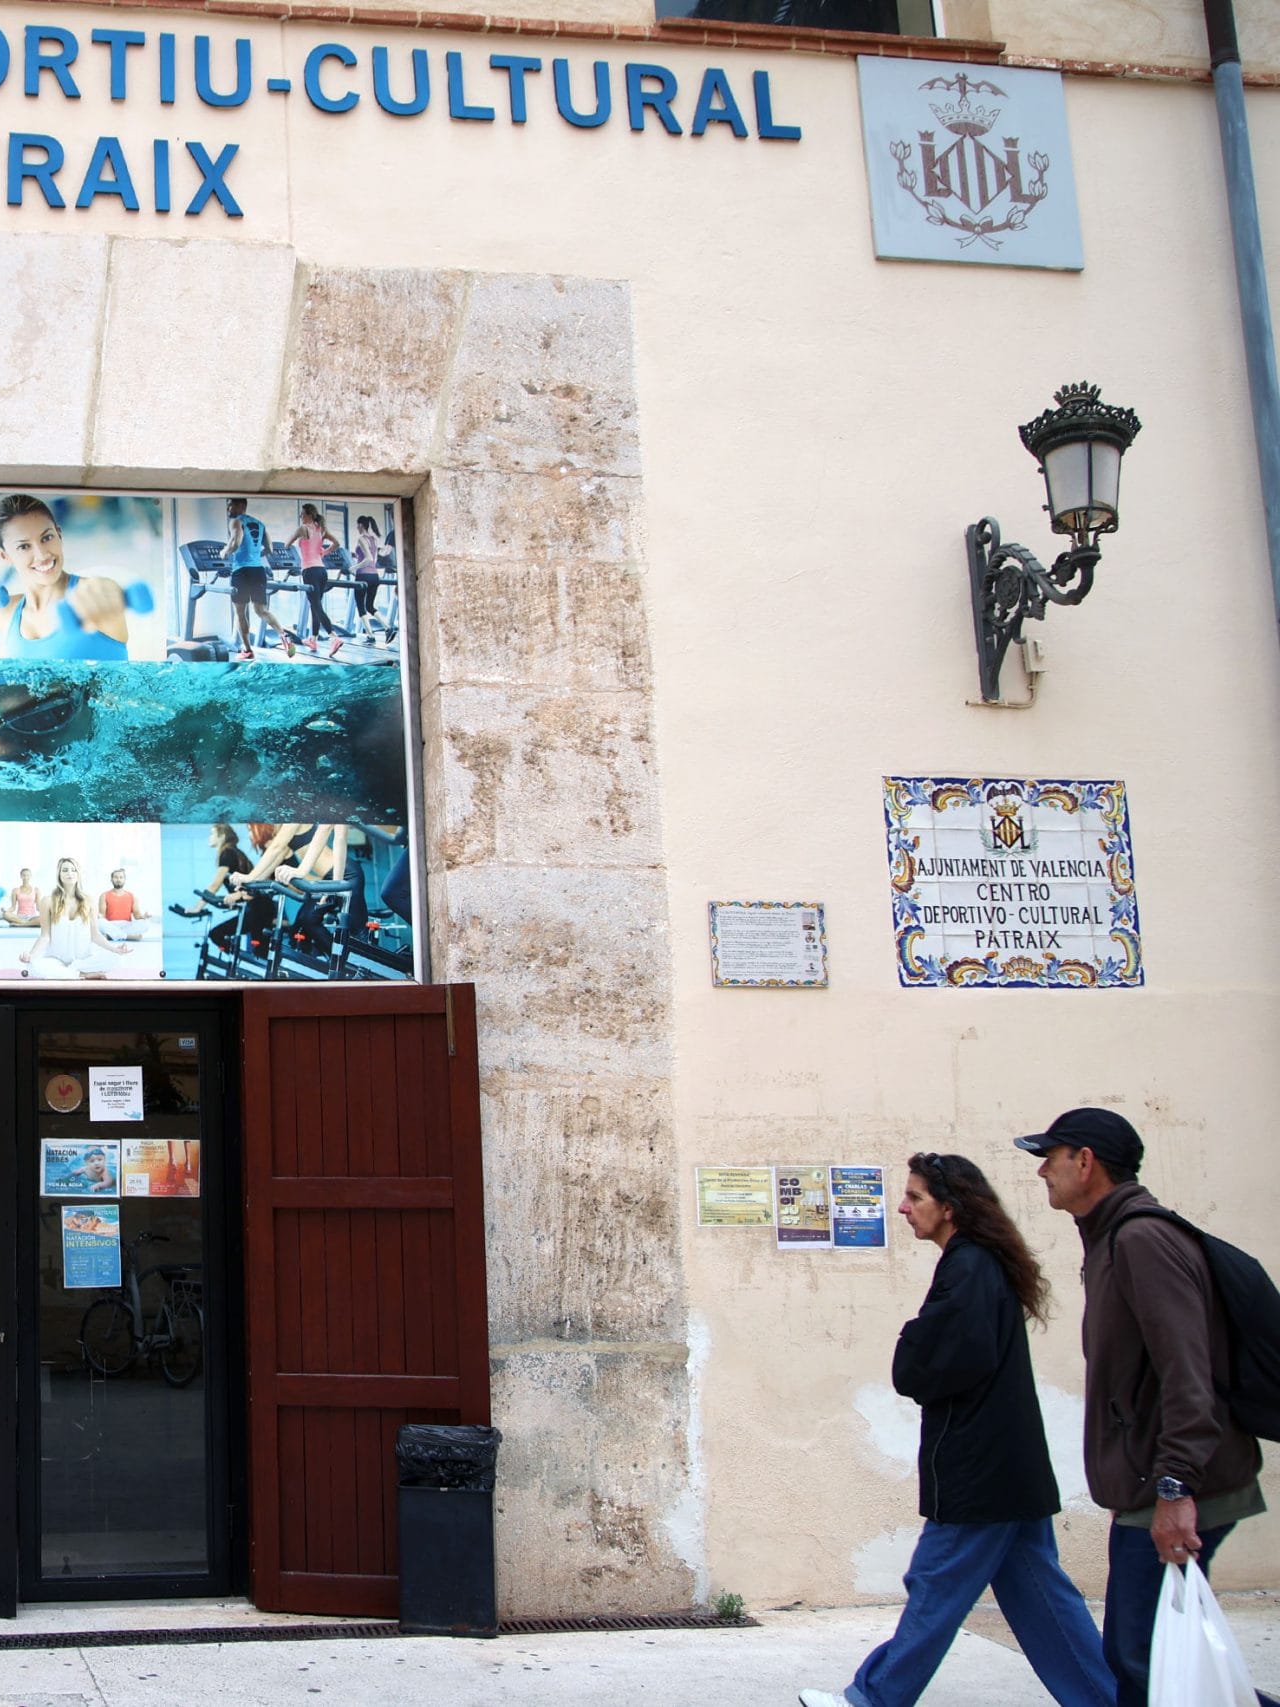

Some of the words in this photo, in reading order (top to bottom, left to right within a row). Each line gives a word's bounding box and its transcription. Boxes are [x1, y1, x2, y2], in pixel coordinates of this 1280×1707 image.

[917, 858, 1007, 877] AJUNTAMENT
[1012, 859, 1027, 877] DE
[1029, 859, 1106, 878] VALENCIA
[976, 883, 1051, 902] CENTRO
[975, 930, 1063, 949] PATRAIX
